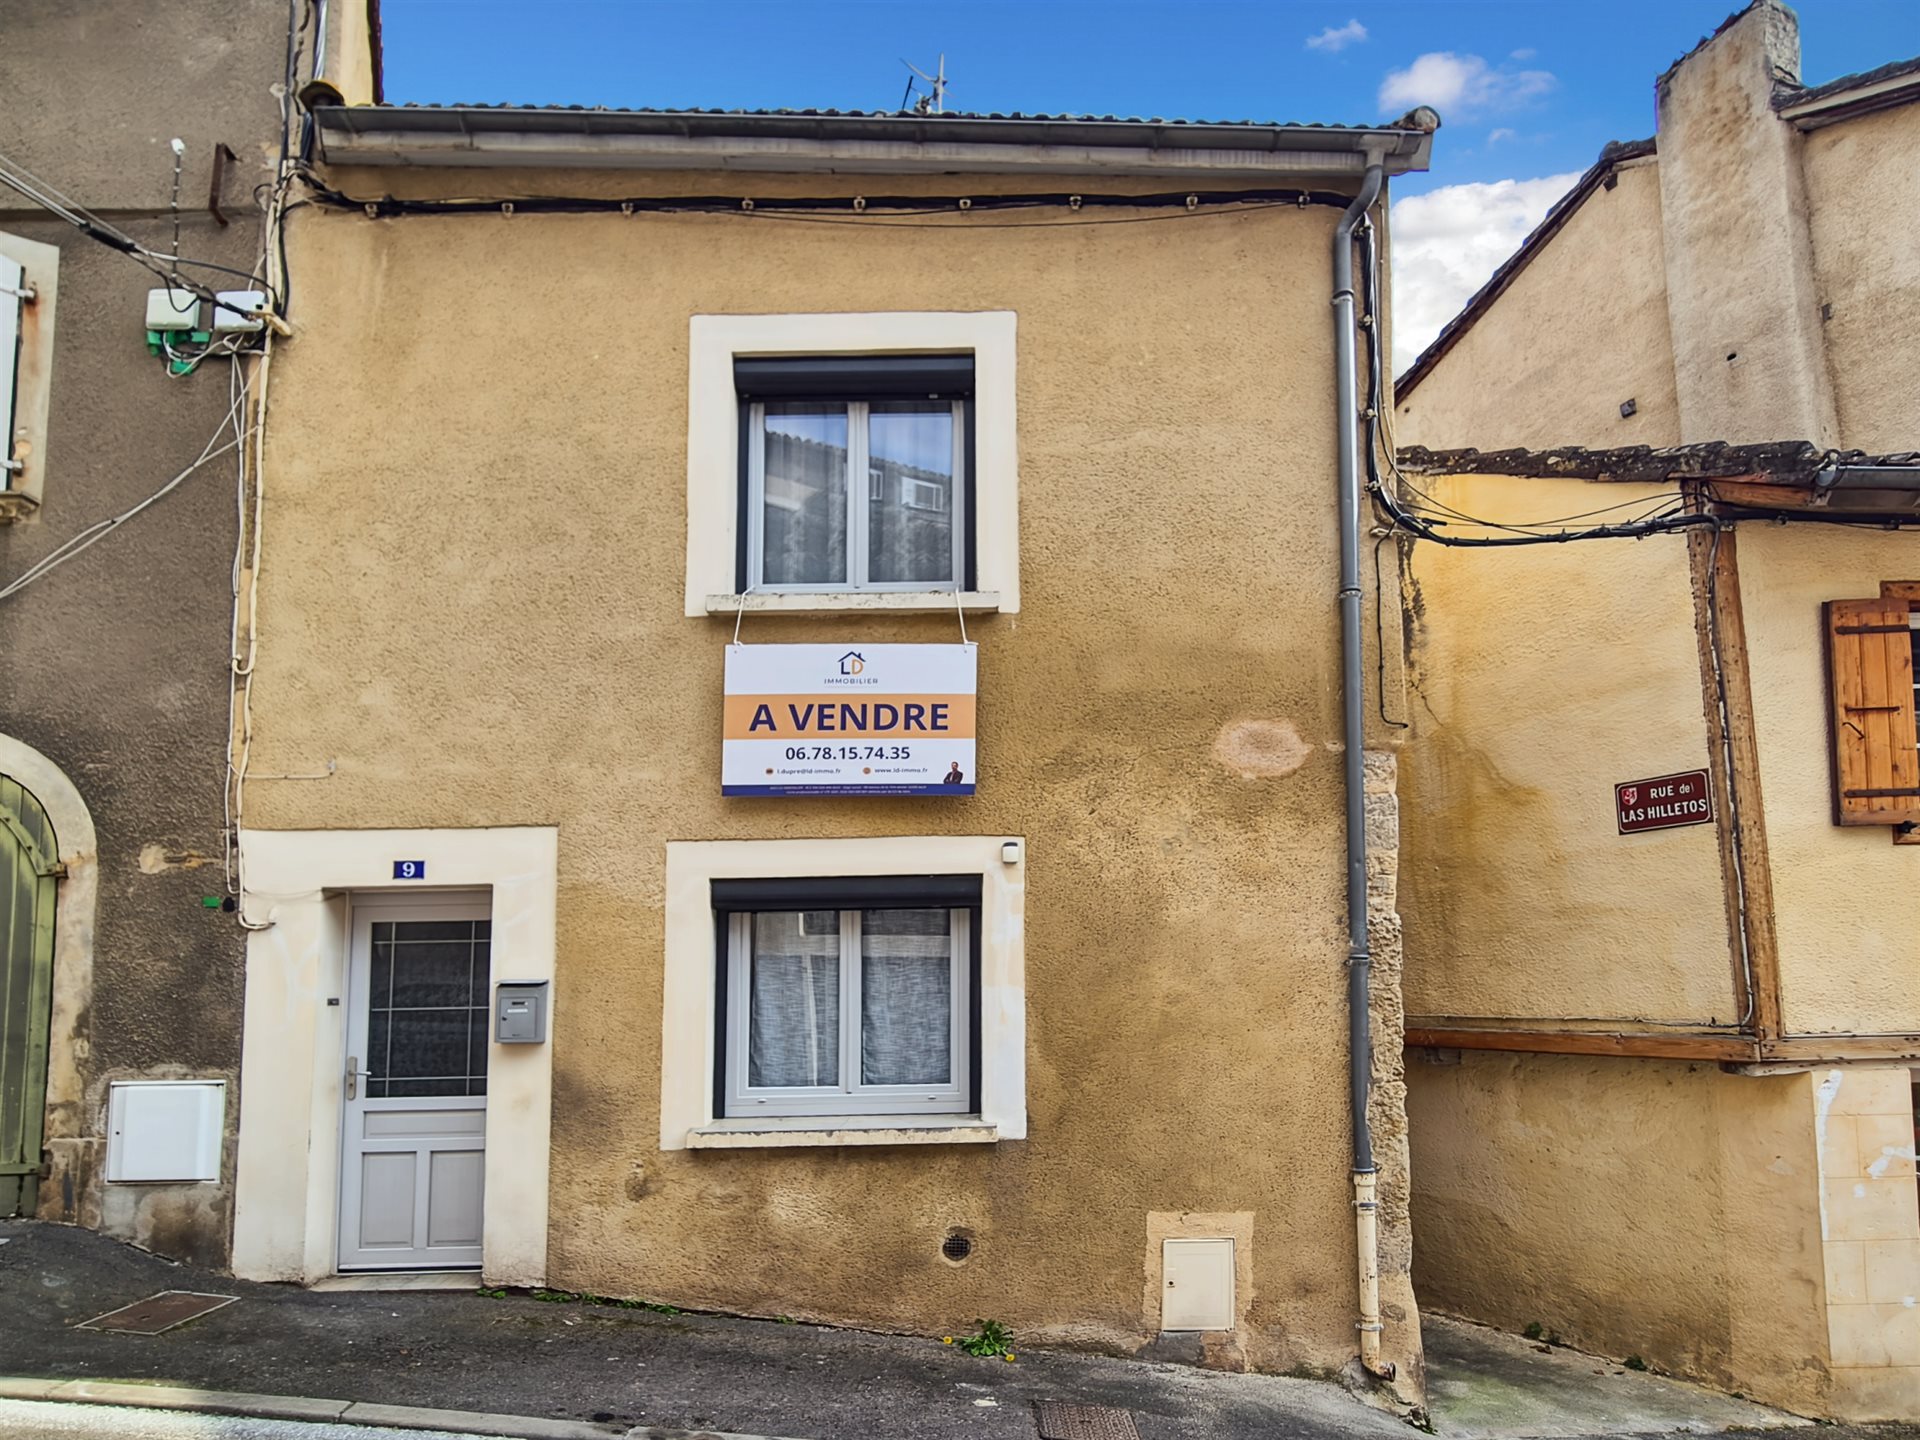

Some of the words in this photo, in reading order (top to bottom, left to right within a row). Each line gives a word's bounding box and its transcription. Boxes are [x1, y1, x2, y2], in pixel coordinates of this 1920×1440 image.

[748, 703, 777, 732] A
[788, 703, 949, 731] VENDRE
[785, 746, 911, 760] 06.78.15.74.35
[1650, 785, 1674, 799] RUE
[1679, 783, 1691, 794] de
[1621, 808, 1645, 823] LAS
[1647, 798, 1707, 819] HILLETOS
[402, 861, 415, 878] 9
